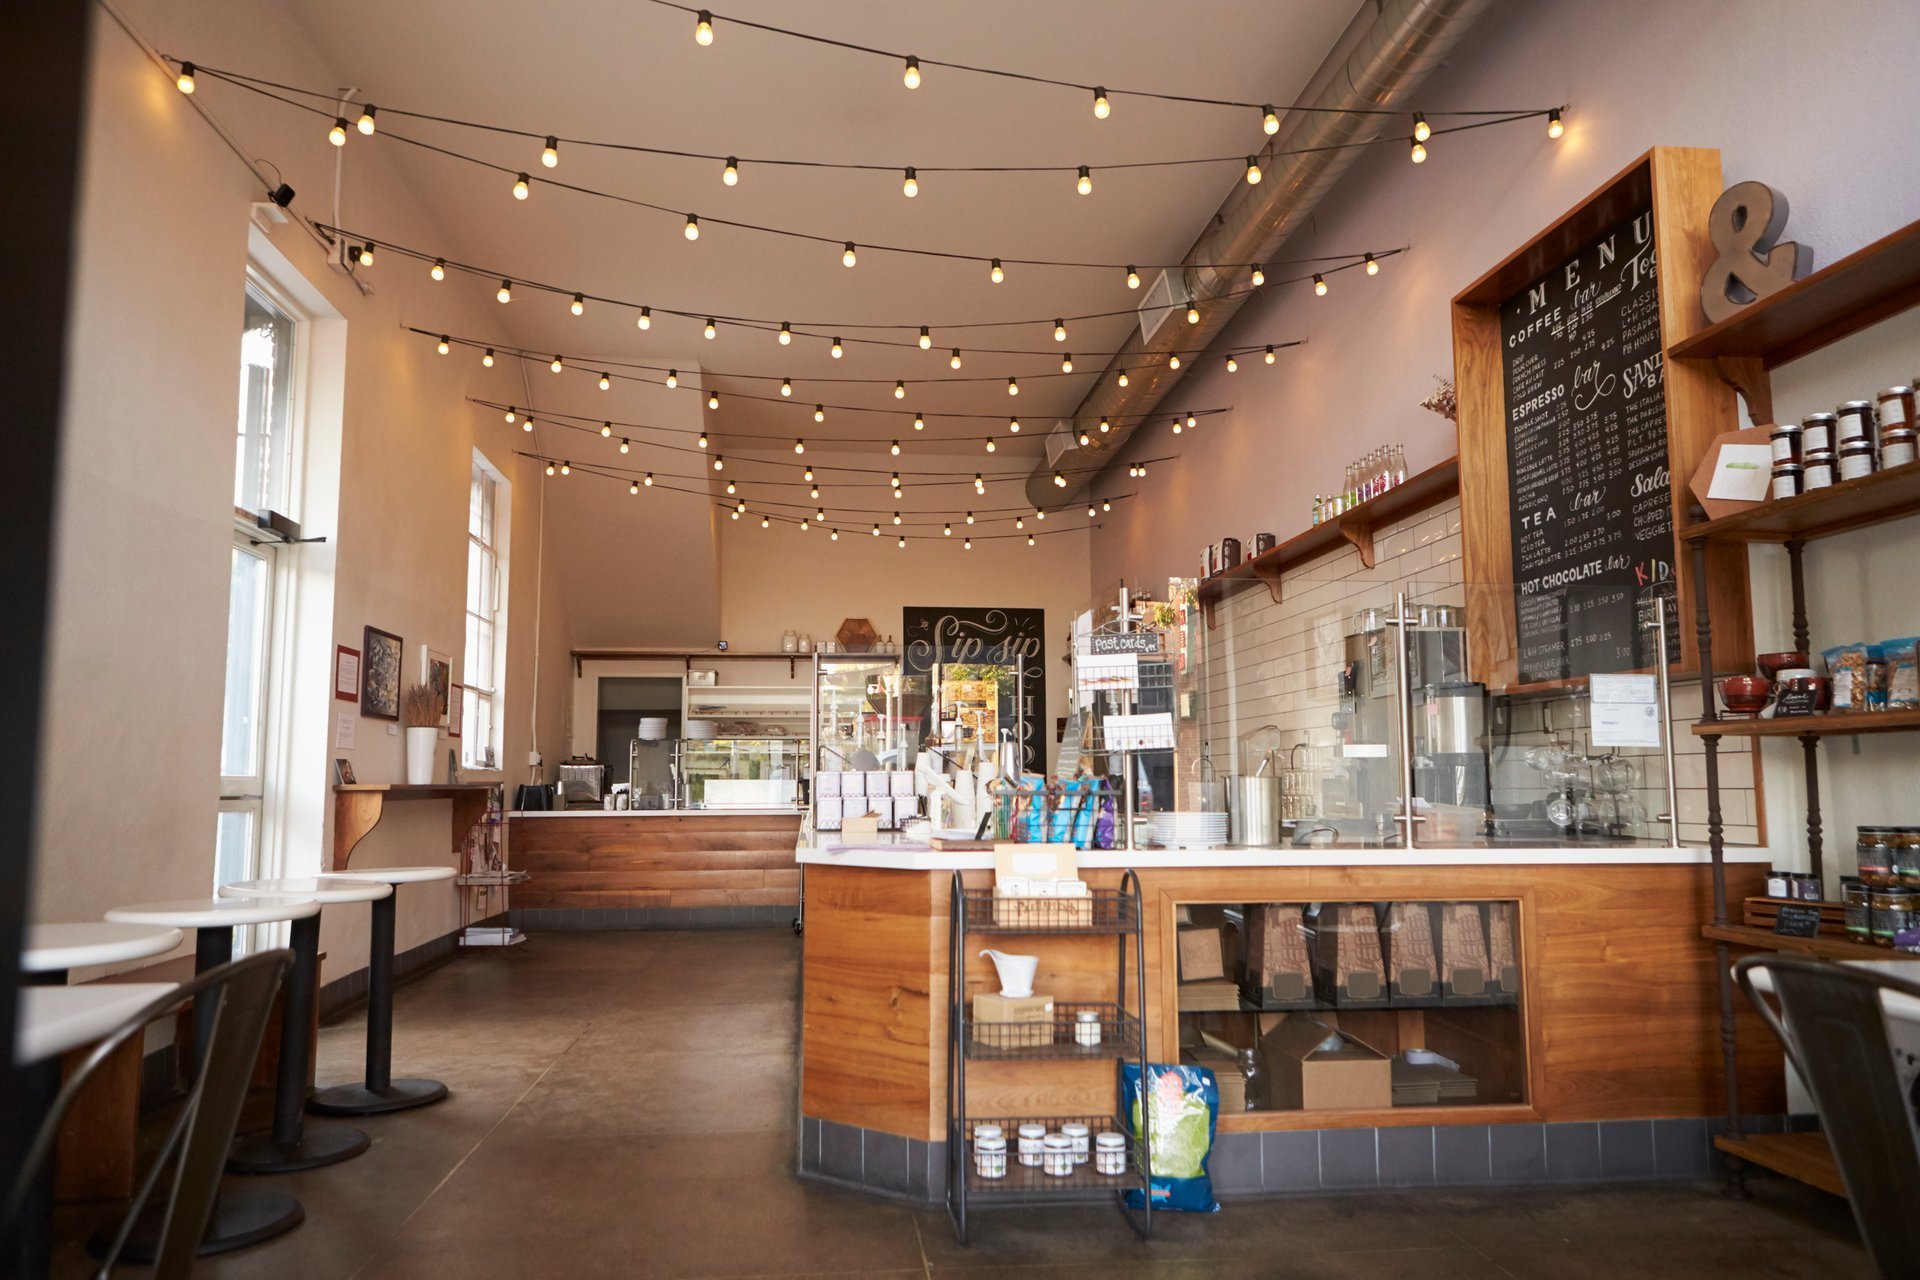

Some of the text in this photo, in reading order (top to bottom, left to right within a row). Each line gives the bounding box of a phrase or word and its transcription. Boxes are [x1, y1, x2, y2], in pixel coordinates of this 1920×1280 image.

[1509, 281, 1601, 348] COFFEE bar
[1622, 312, 1658, 342] PASADEN
[1634, 328, 1660, 350] HONEY
[1512, 360, 1616, 421] ESPRESSO bar
[1521, 486, 1607, 530] TEA bar
[1634, 509, 1664, 526] CHOPPED
[1635, 523, 1666, 541] VEGGIE
[1533, 546, 1551, 558] LATTE
[1545, 552, 1561, 564] LATTE
[1521, 554, 1631, 596] HOT CHOCOLATE bar
[908, 612, 984, 671] Sip
